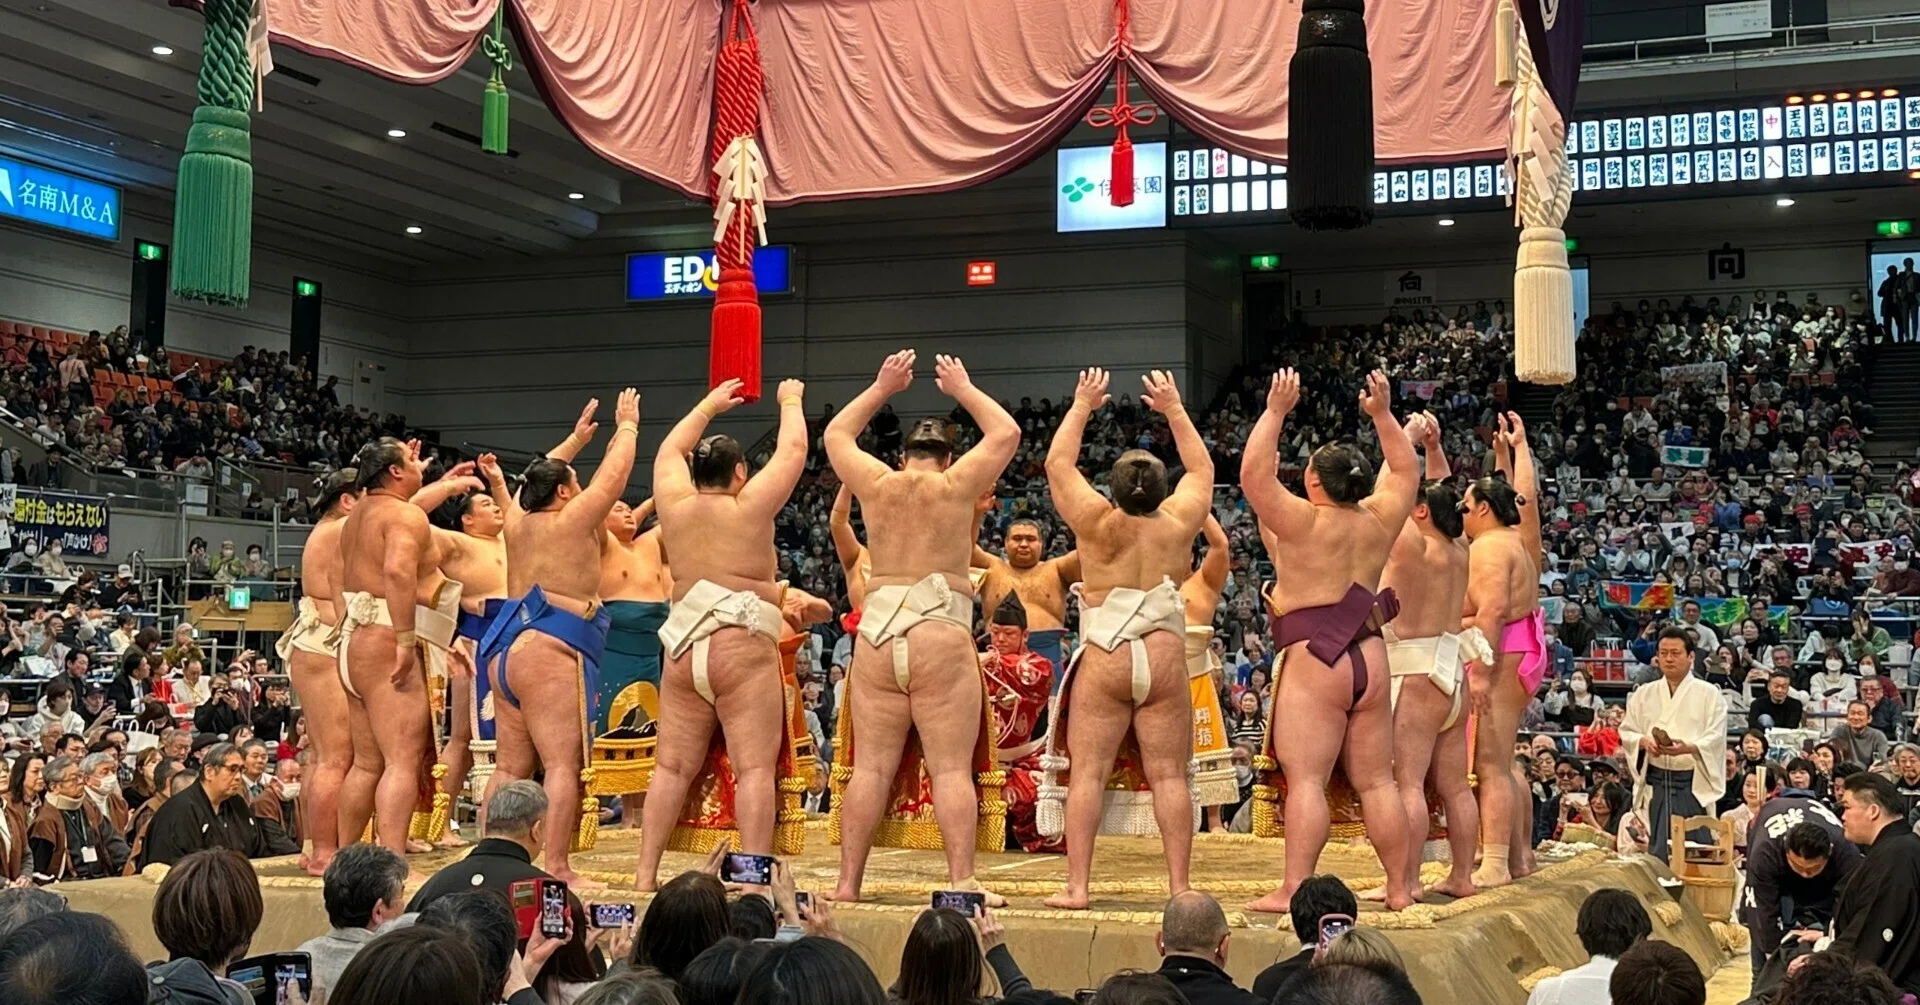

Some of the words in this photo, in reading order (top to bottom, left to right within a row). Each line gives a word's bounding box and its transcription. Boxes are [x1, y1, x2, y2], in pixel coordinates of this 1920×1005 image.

[1765, 115, 1778, 129] 中
[1675, 155, 1687, 180] 明生
[1768, 156, 1781, 168] 入
[18, 179, 114, 226] 名南M&A
[1708, 242, 1746, 280] 向
[1195, 708, 1213, 746] 翔猿
